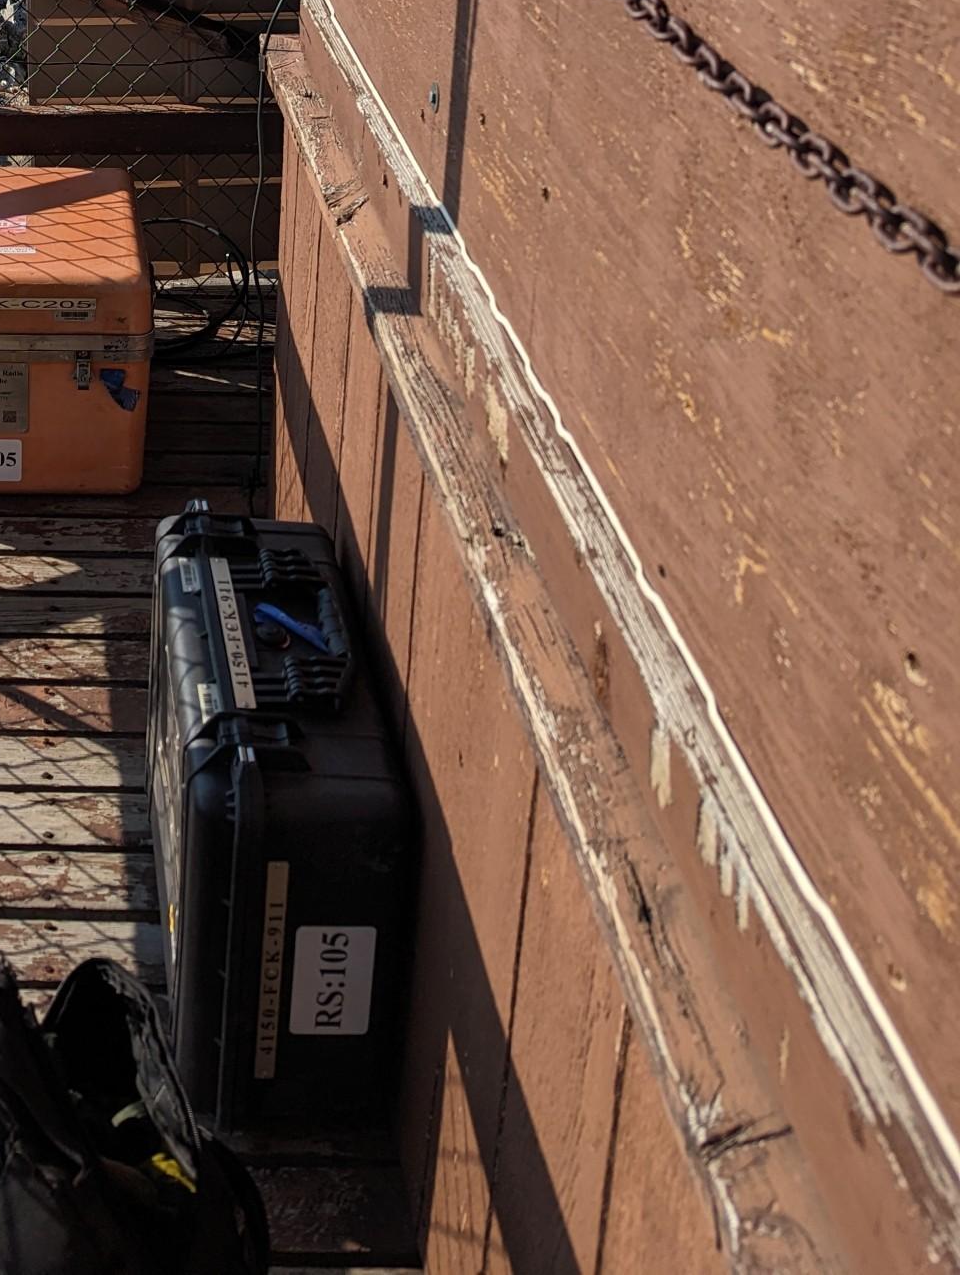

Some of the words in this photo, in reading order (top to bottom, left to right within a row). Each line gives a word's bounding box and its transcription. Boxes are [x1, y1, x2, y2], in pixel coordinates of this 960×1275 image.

[217, 579, 250, 689] 4150-FCK-911
[259, 901, 284, 1056] 4150-FCK-911
[314, 932, 350, 1029] RS:105
